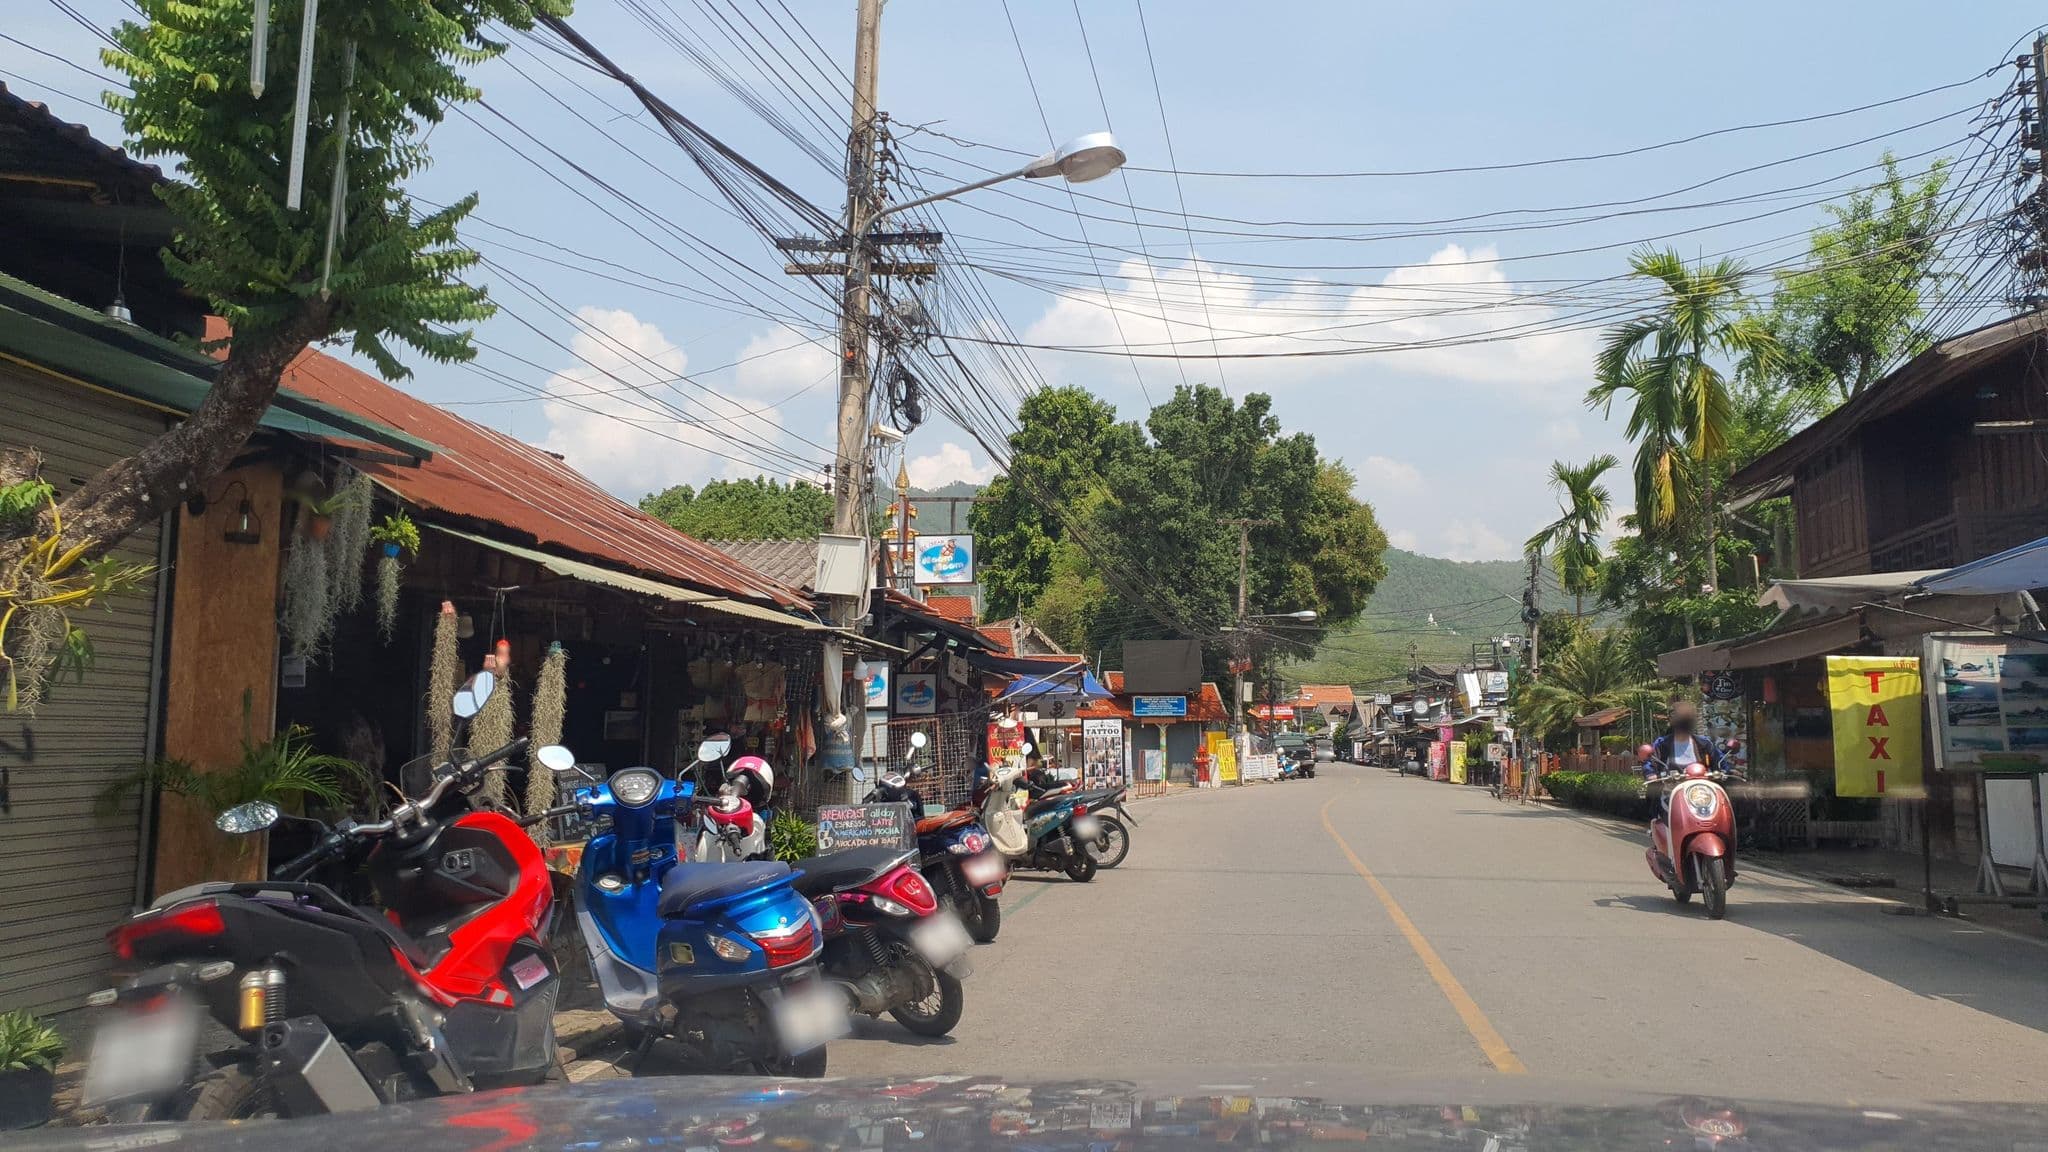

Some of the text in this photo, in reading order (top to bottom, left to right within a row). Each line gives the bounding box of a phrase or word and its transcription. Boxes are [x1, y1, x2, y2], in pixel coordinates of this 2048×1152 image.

[1863, 671, 1891, 793] TAXI
[992, 747, 1025, 759] Waxing
[821, 808, 867, 820] BREAKFAST
